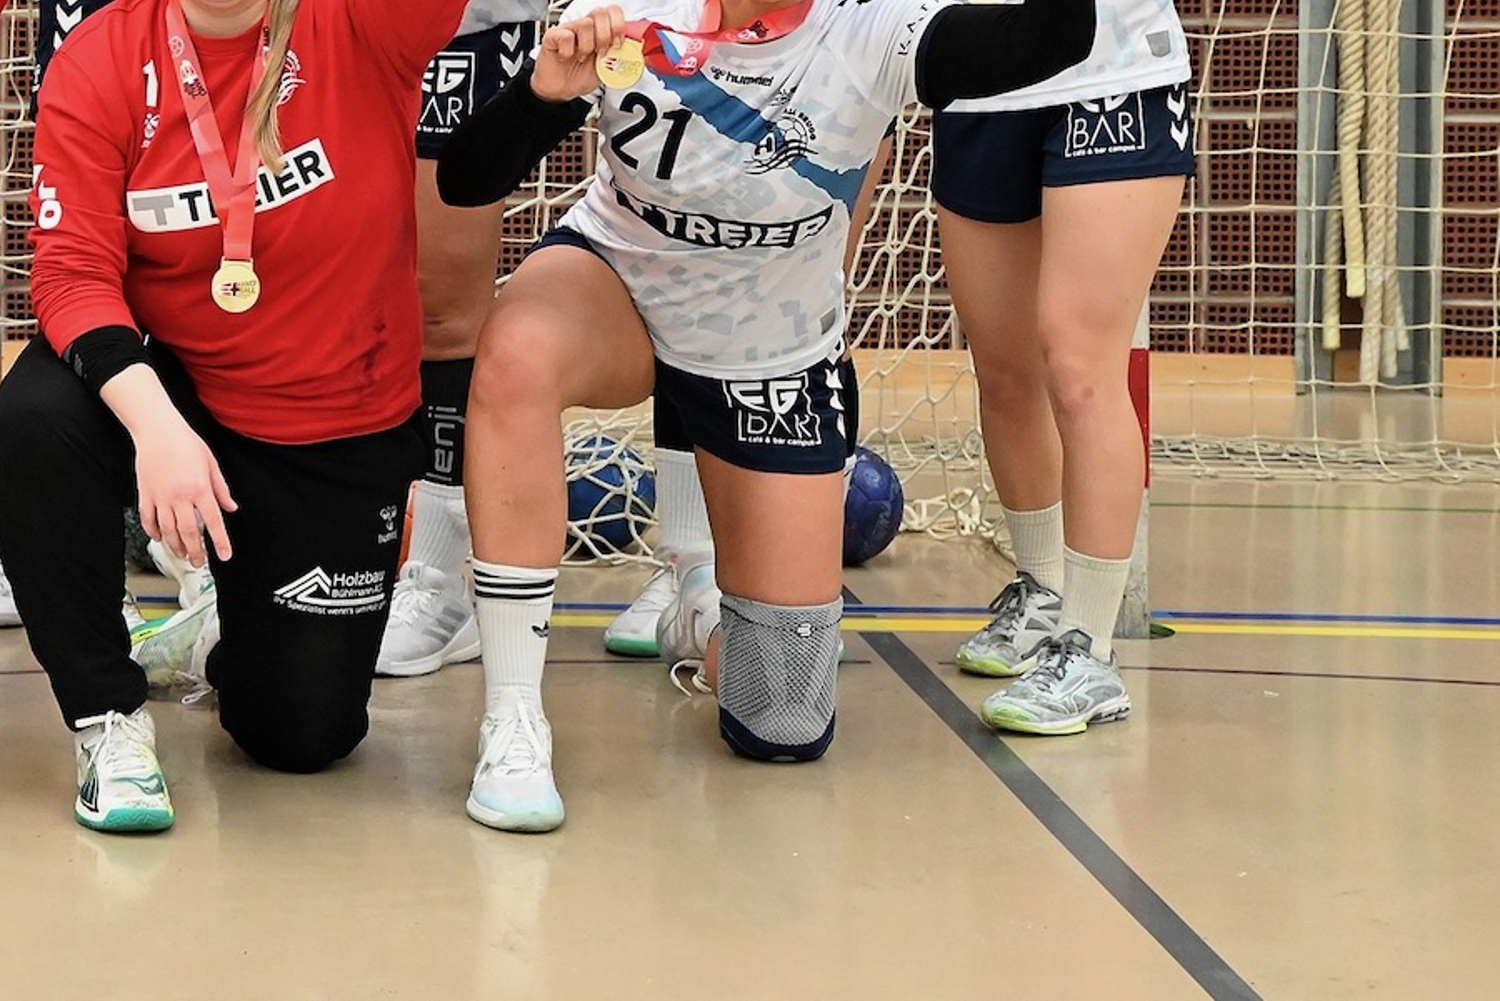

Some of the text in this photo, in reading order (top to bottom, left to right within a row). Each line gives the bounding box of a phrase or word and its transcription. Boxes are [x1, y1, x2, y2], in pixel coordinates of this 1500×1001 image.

[725, 71, 775, 87] hummel
[419, 95, 464, 127] AR
[610, 91, 693, 180] 21
[1072, 111, 1137, 149] BAR
